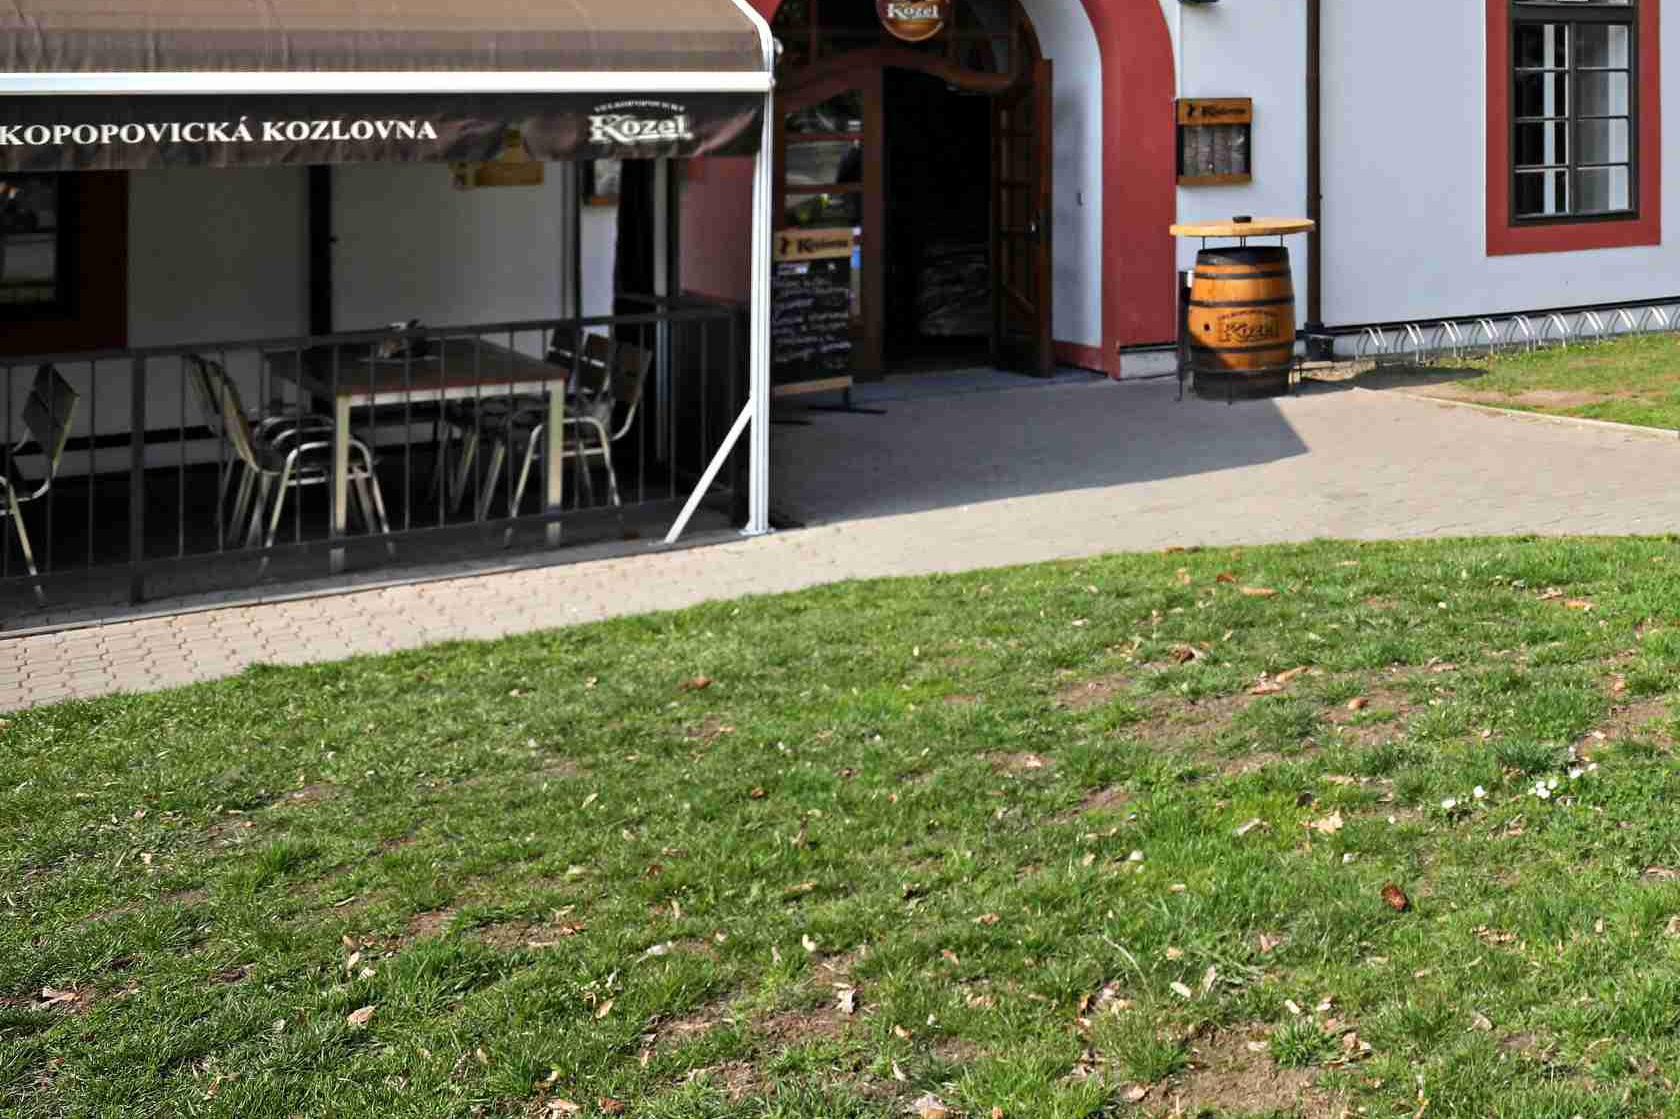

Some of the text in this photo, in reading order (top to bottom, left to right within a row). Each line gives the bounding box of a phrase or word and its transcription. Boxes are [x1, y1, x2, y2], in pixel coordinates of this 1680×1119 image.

[0, 116, 438, 145] KOPOPOVICKÁ KOZLOVNA
[588, 114, 694, 146] Kozel
